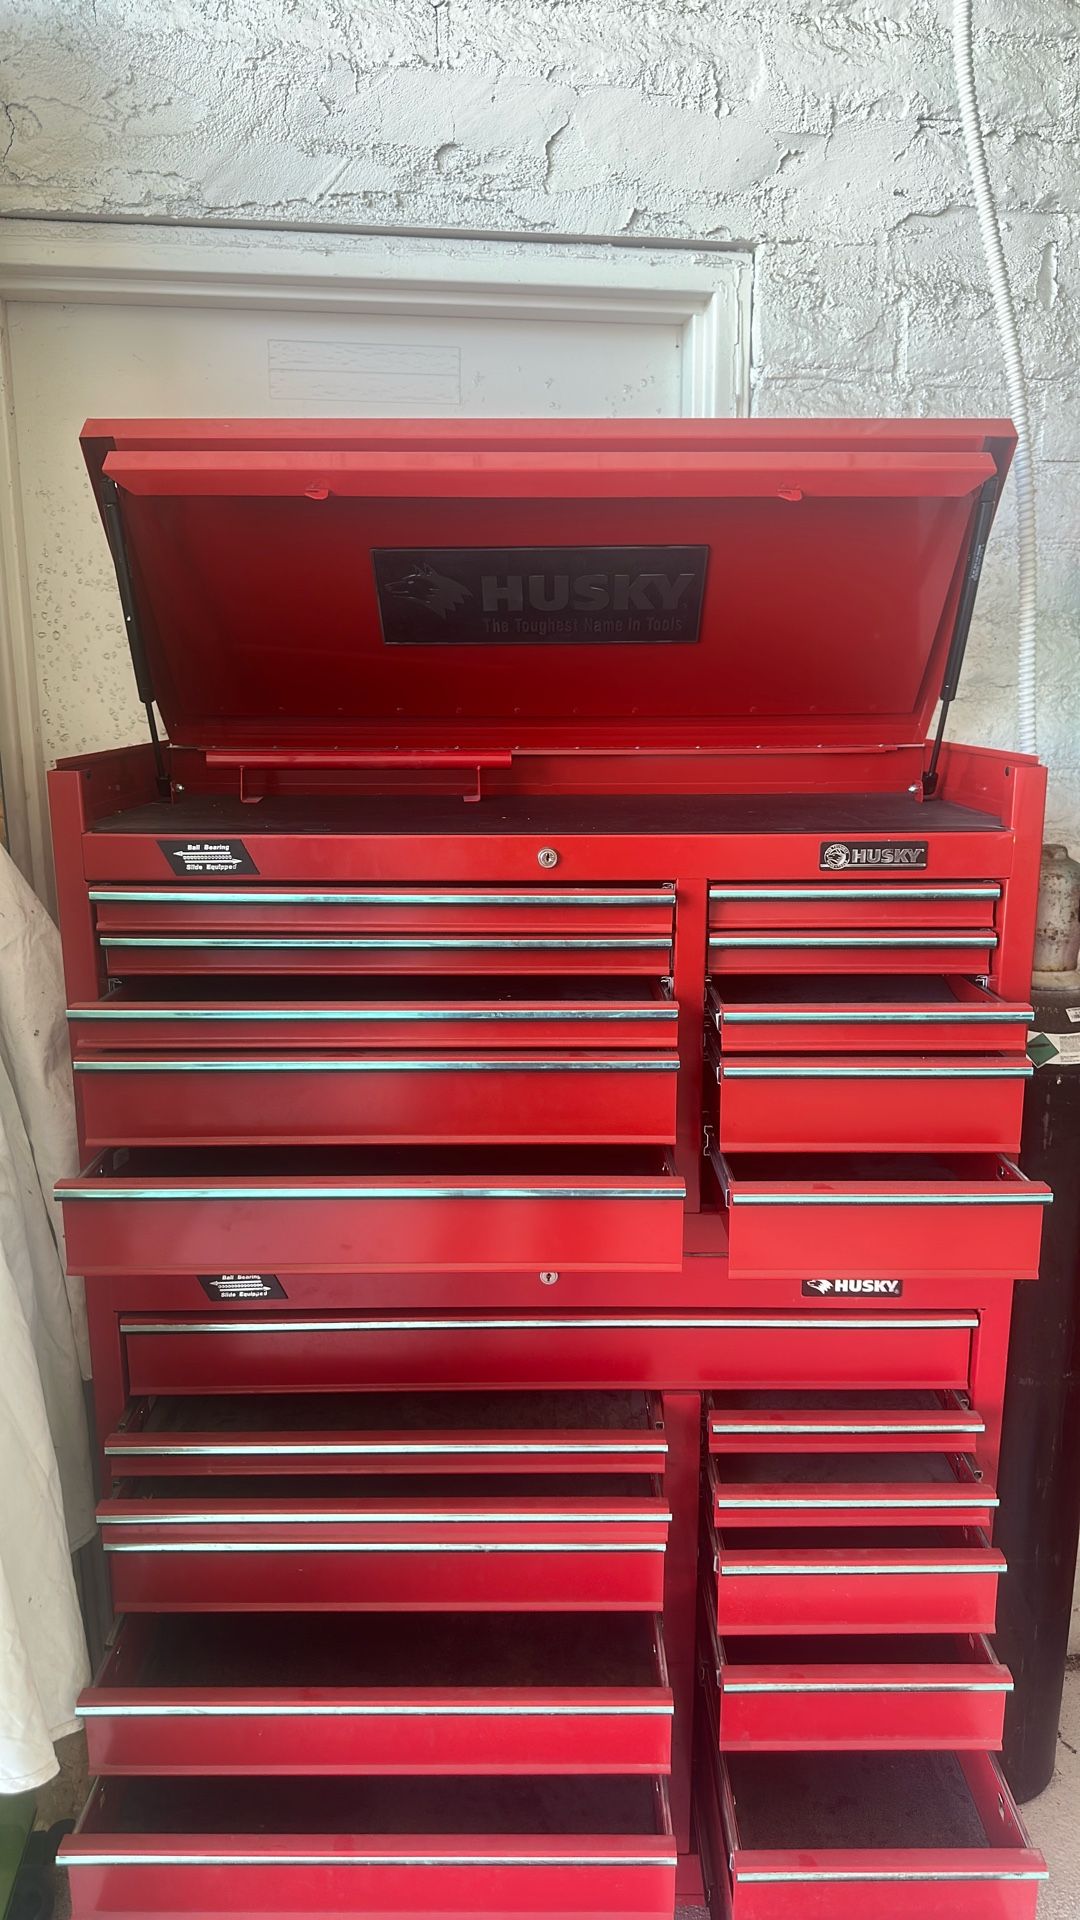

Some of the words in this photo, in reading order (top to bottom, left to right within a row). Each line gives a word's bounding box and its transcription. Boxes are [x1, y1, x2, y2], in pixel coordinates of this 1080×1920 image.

[481, 573, 696, 611] HUSKY
[483, 618, 508, 632] The
[515, 617, 578, 635] Toughest
[584, 617, 624, 632] Name
[628, 617, 641, 631] In
[647, 616, 683, 631] Tools
[851, 848, 921, 863] HUSKY
[834, 1279, 899, 1292] HUSKY
[239, 1290, 268, 1298] Equipped
